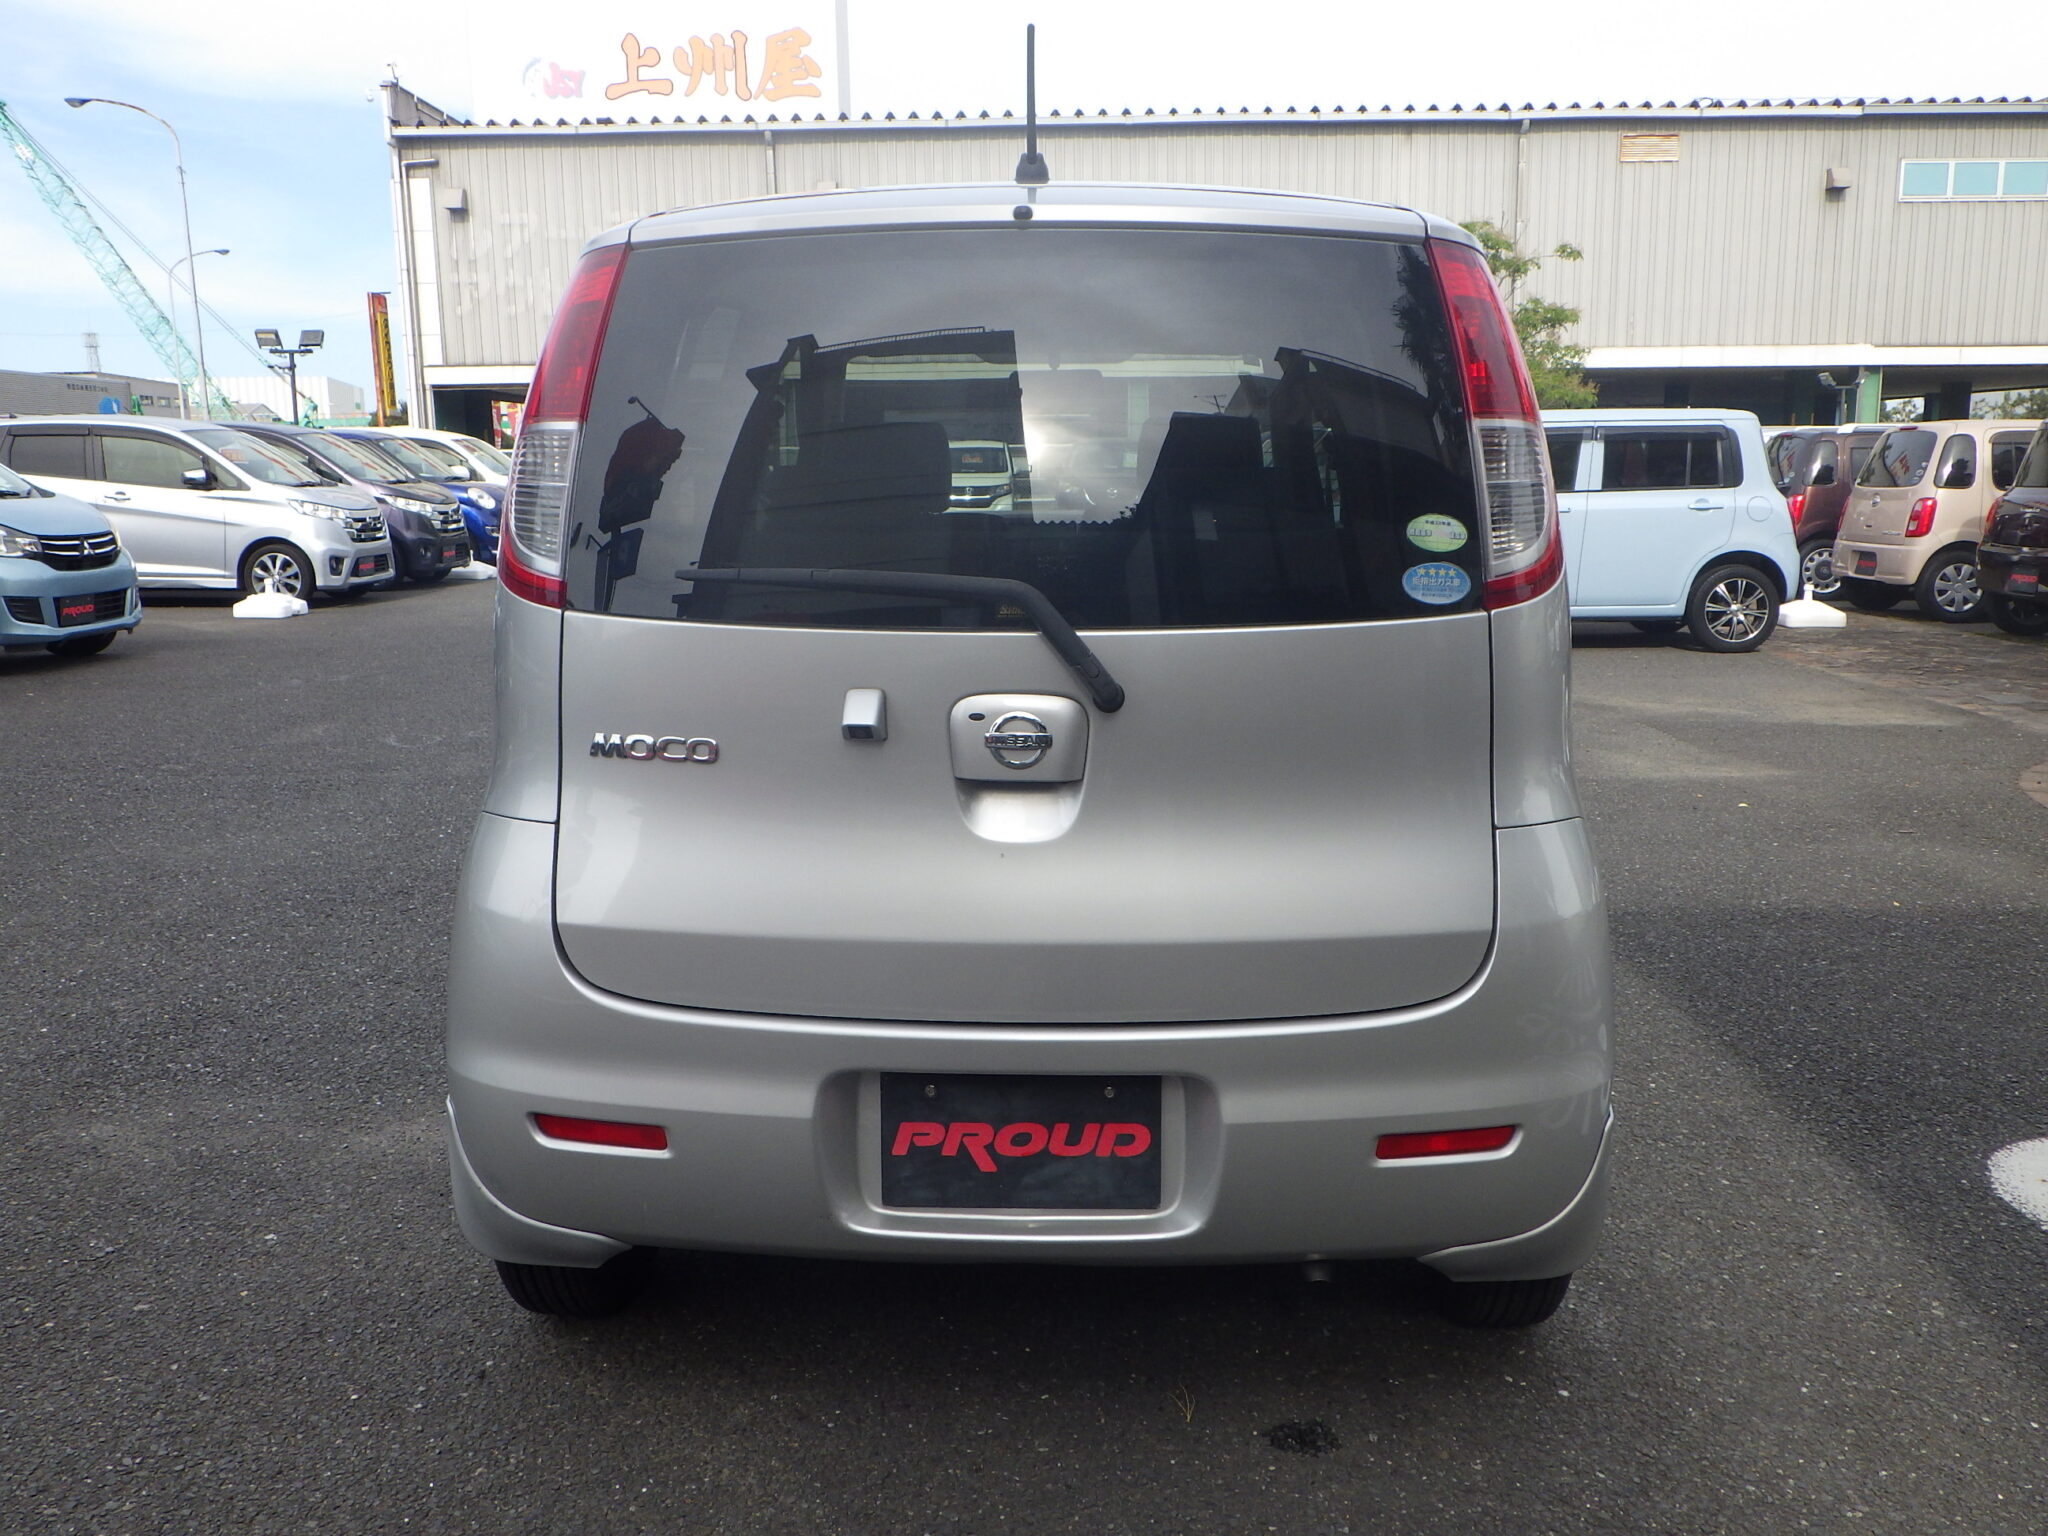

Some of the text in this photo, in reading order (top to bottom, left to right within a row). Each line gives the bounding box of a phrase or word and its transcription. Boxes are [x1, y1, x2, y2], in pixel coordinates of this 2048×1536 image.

[605, 27, 822, 101] 上州屋
[62, 603, 95, 617] PROUD
[590, 732, 719, 764] MOCO
[891, 1121, 1152, 1172] PROUD
